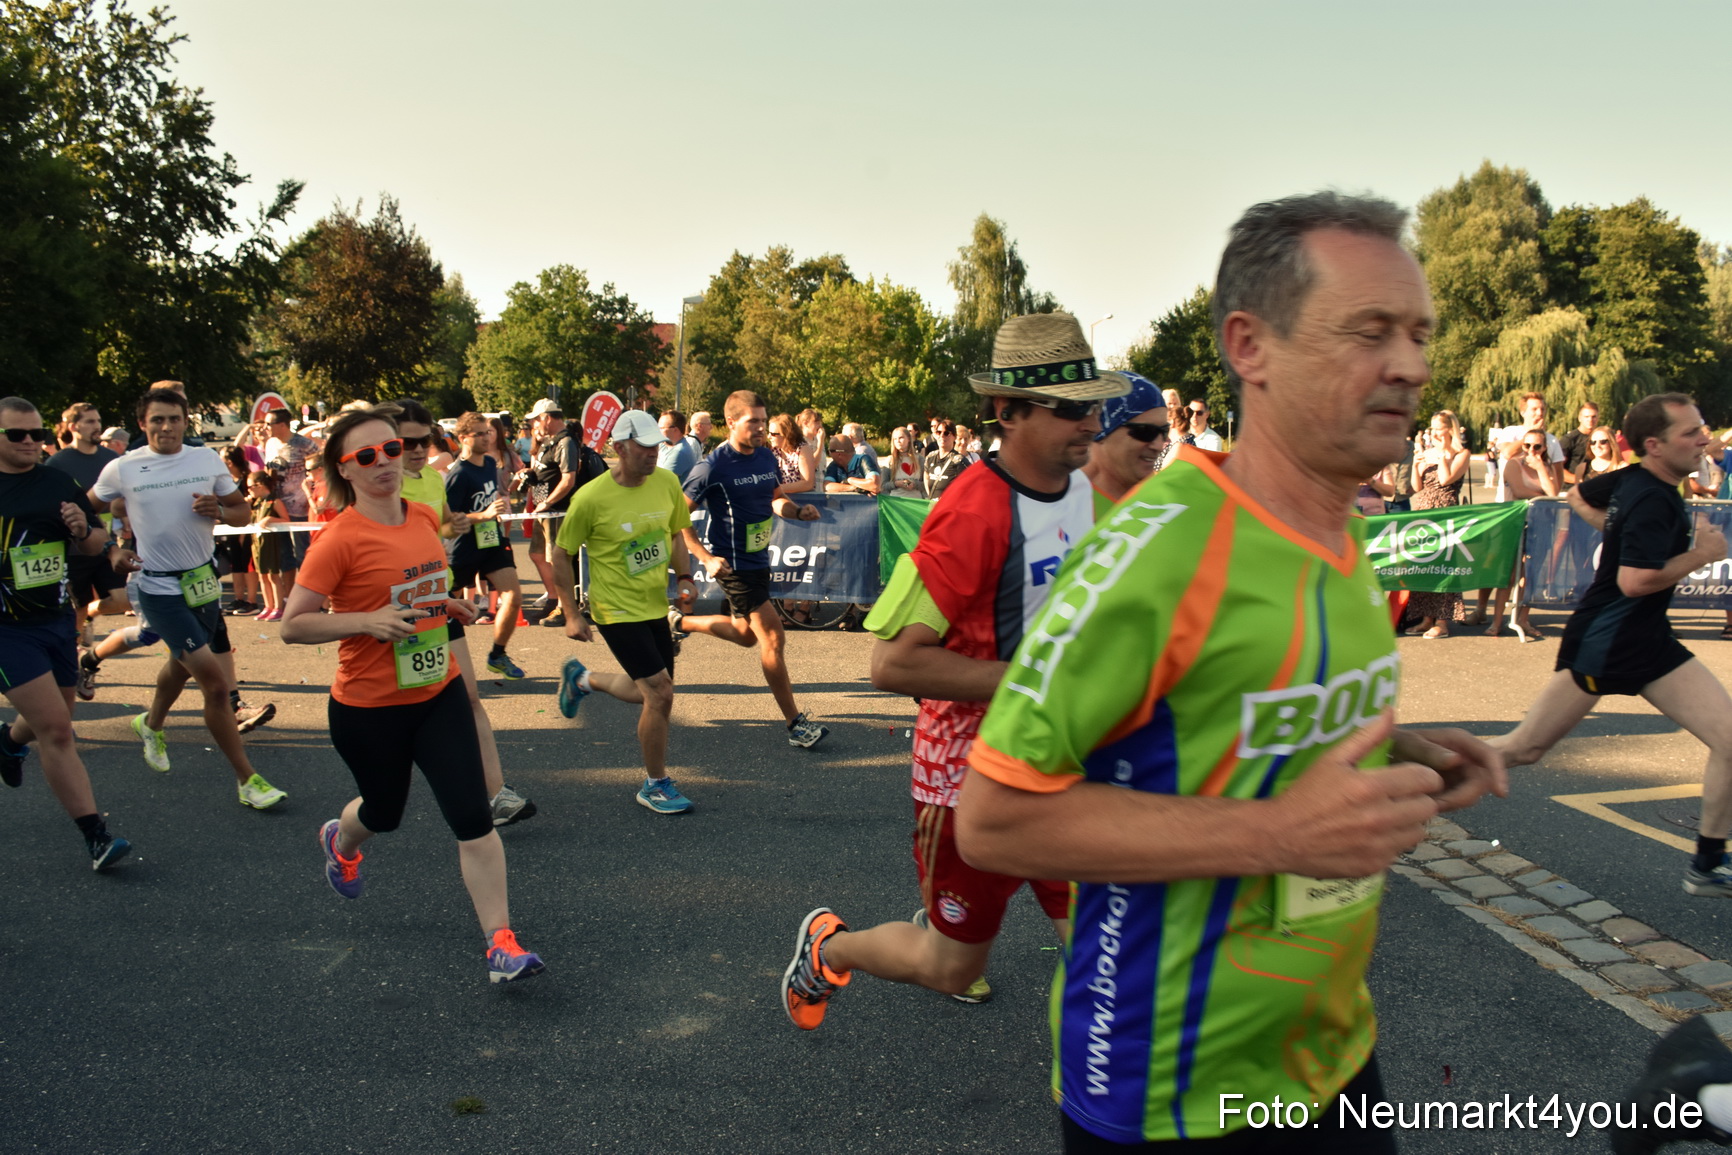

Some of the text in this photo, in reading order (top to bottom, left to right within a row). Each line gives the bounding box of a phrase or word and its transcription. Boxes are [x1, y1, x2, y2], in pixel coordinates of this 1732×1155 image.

[133, 476, 210, 492] RUPPRECHT HOLZBAU
[1365, 519, 1479, 563] AOK
[634, 544, 659, 565] 906
[21, 556, 60, 576] 1425
[403, 560, 442, 580] 30 Jahre
[412, 647, 445, 672] 895
[1236, 651, 1398, 759] BOC
